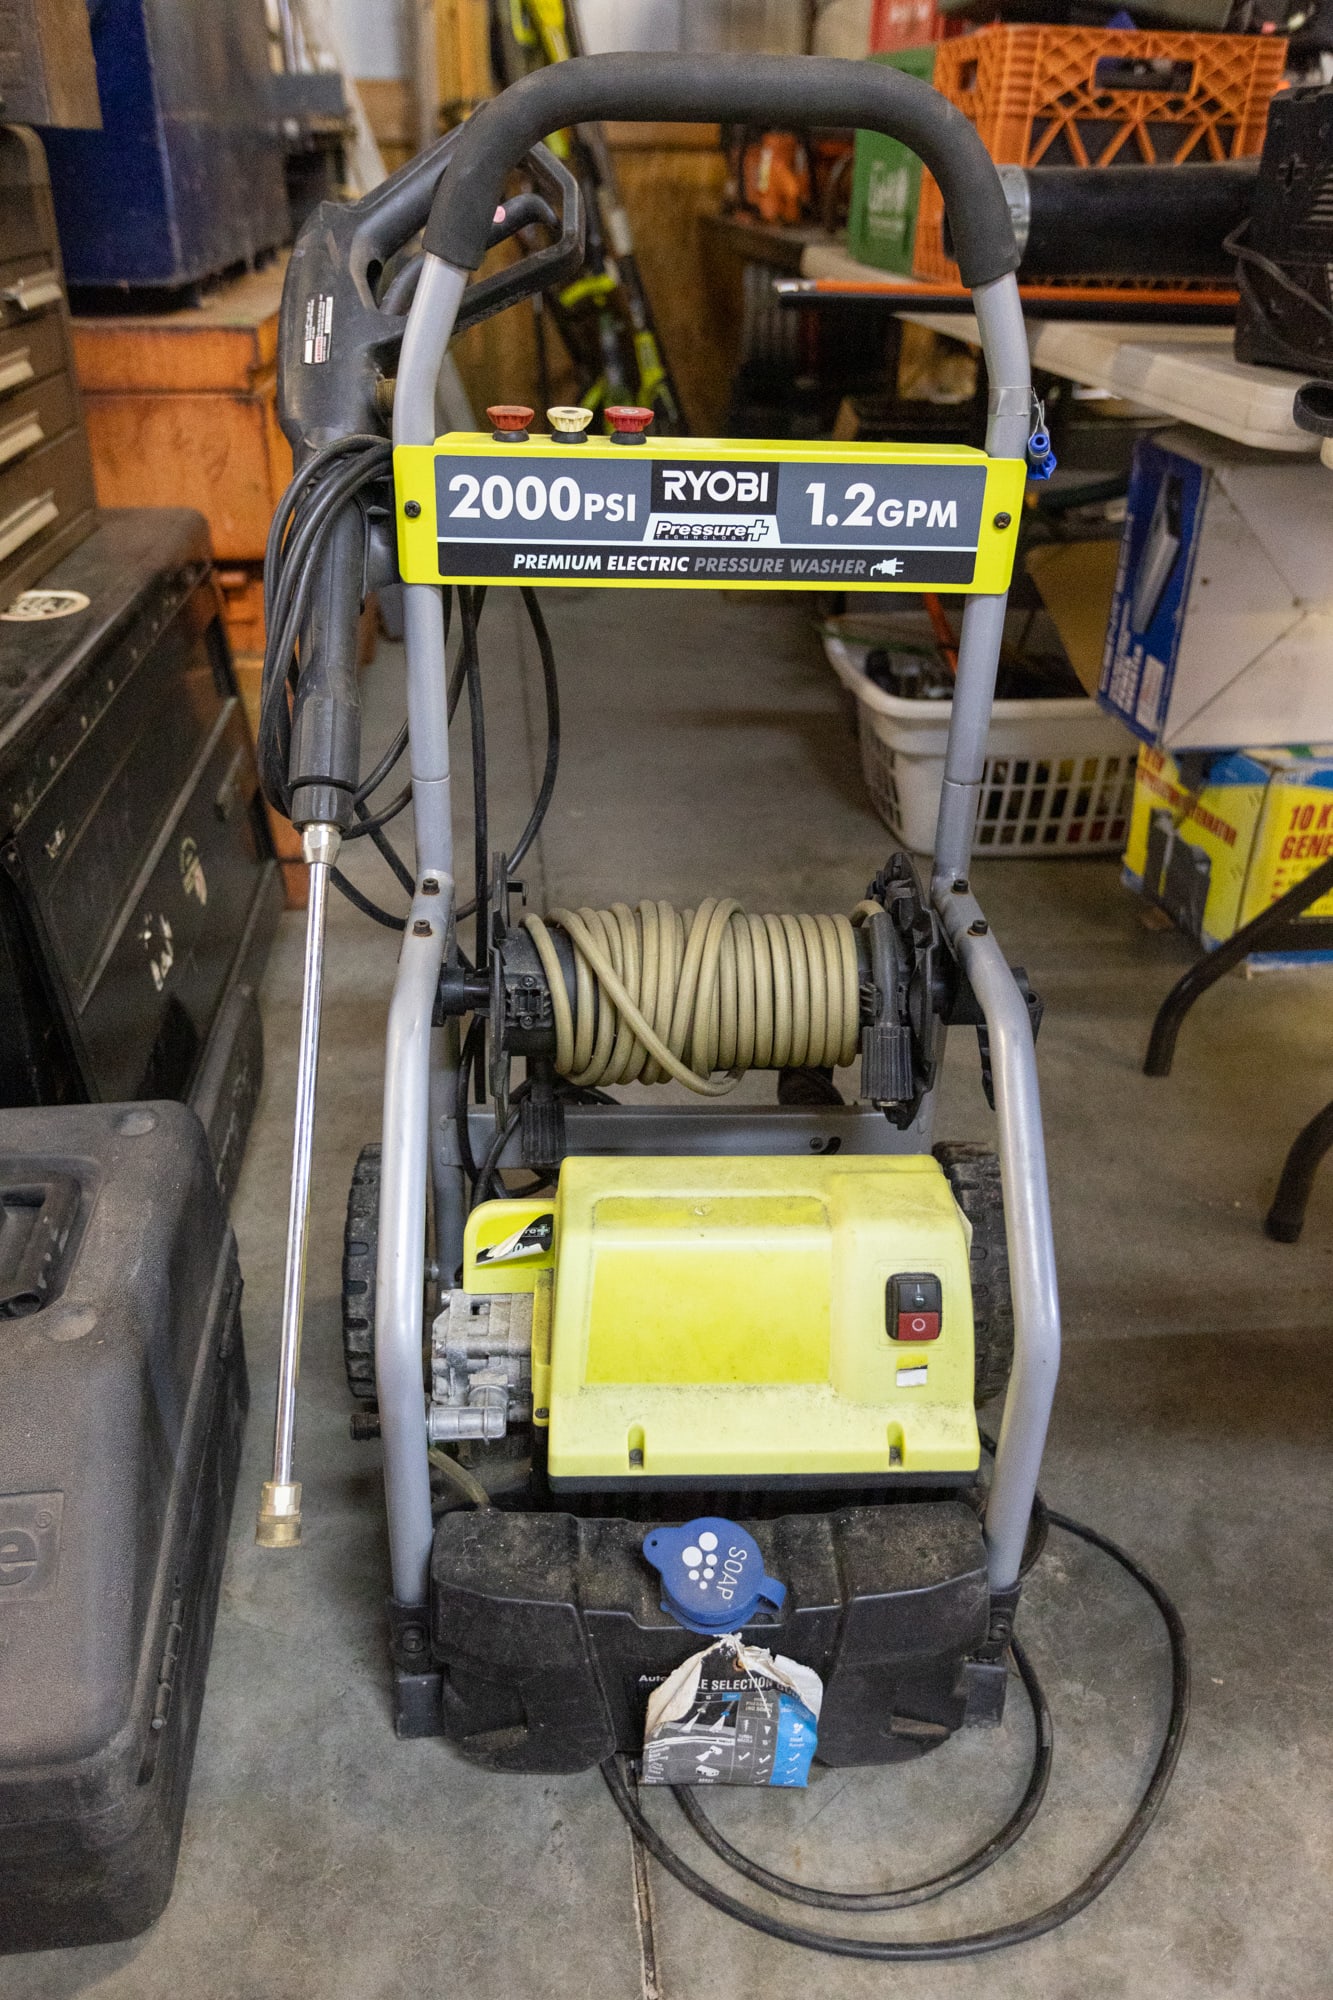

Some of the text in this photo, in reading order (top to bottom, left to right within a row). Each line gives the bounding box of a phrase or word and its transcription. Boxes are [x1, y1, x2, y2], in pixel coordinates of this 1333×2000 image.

[662, 470, 769, 502] RYOBI
[513, 553, 867, 574] PREMIUM ELECTRIC PRESSURE WASHER
[1289, 804, 1315, 831] 10
[716, 1546, 748, 1600] SOAP
[711, 1676, 773, 1691] SELECTION
